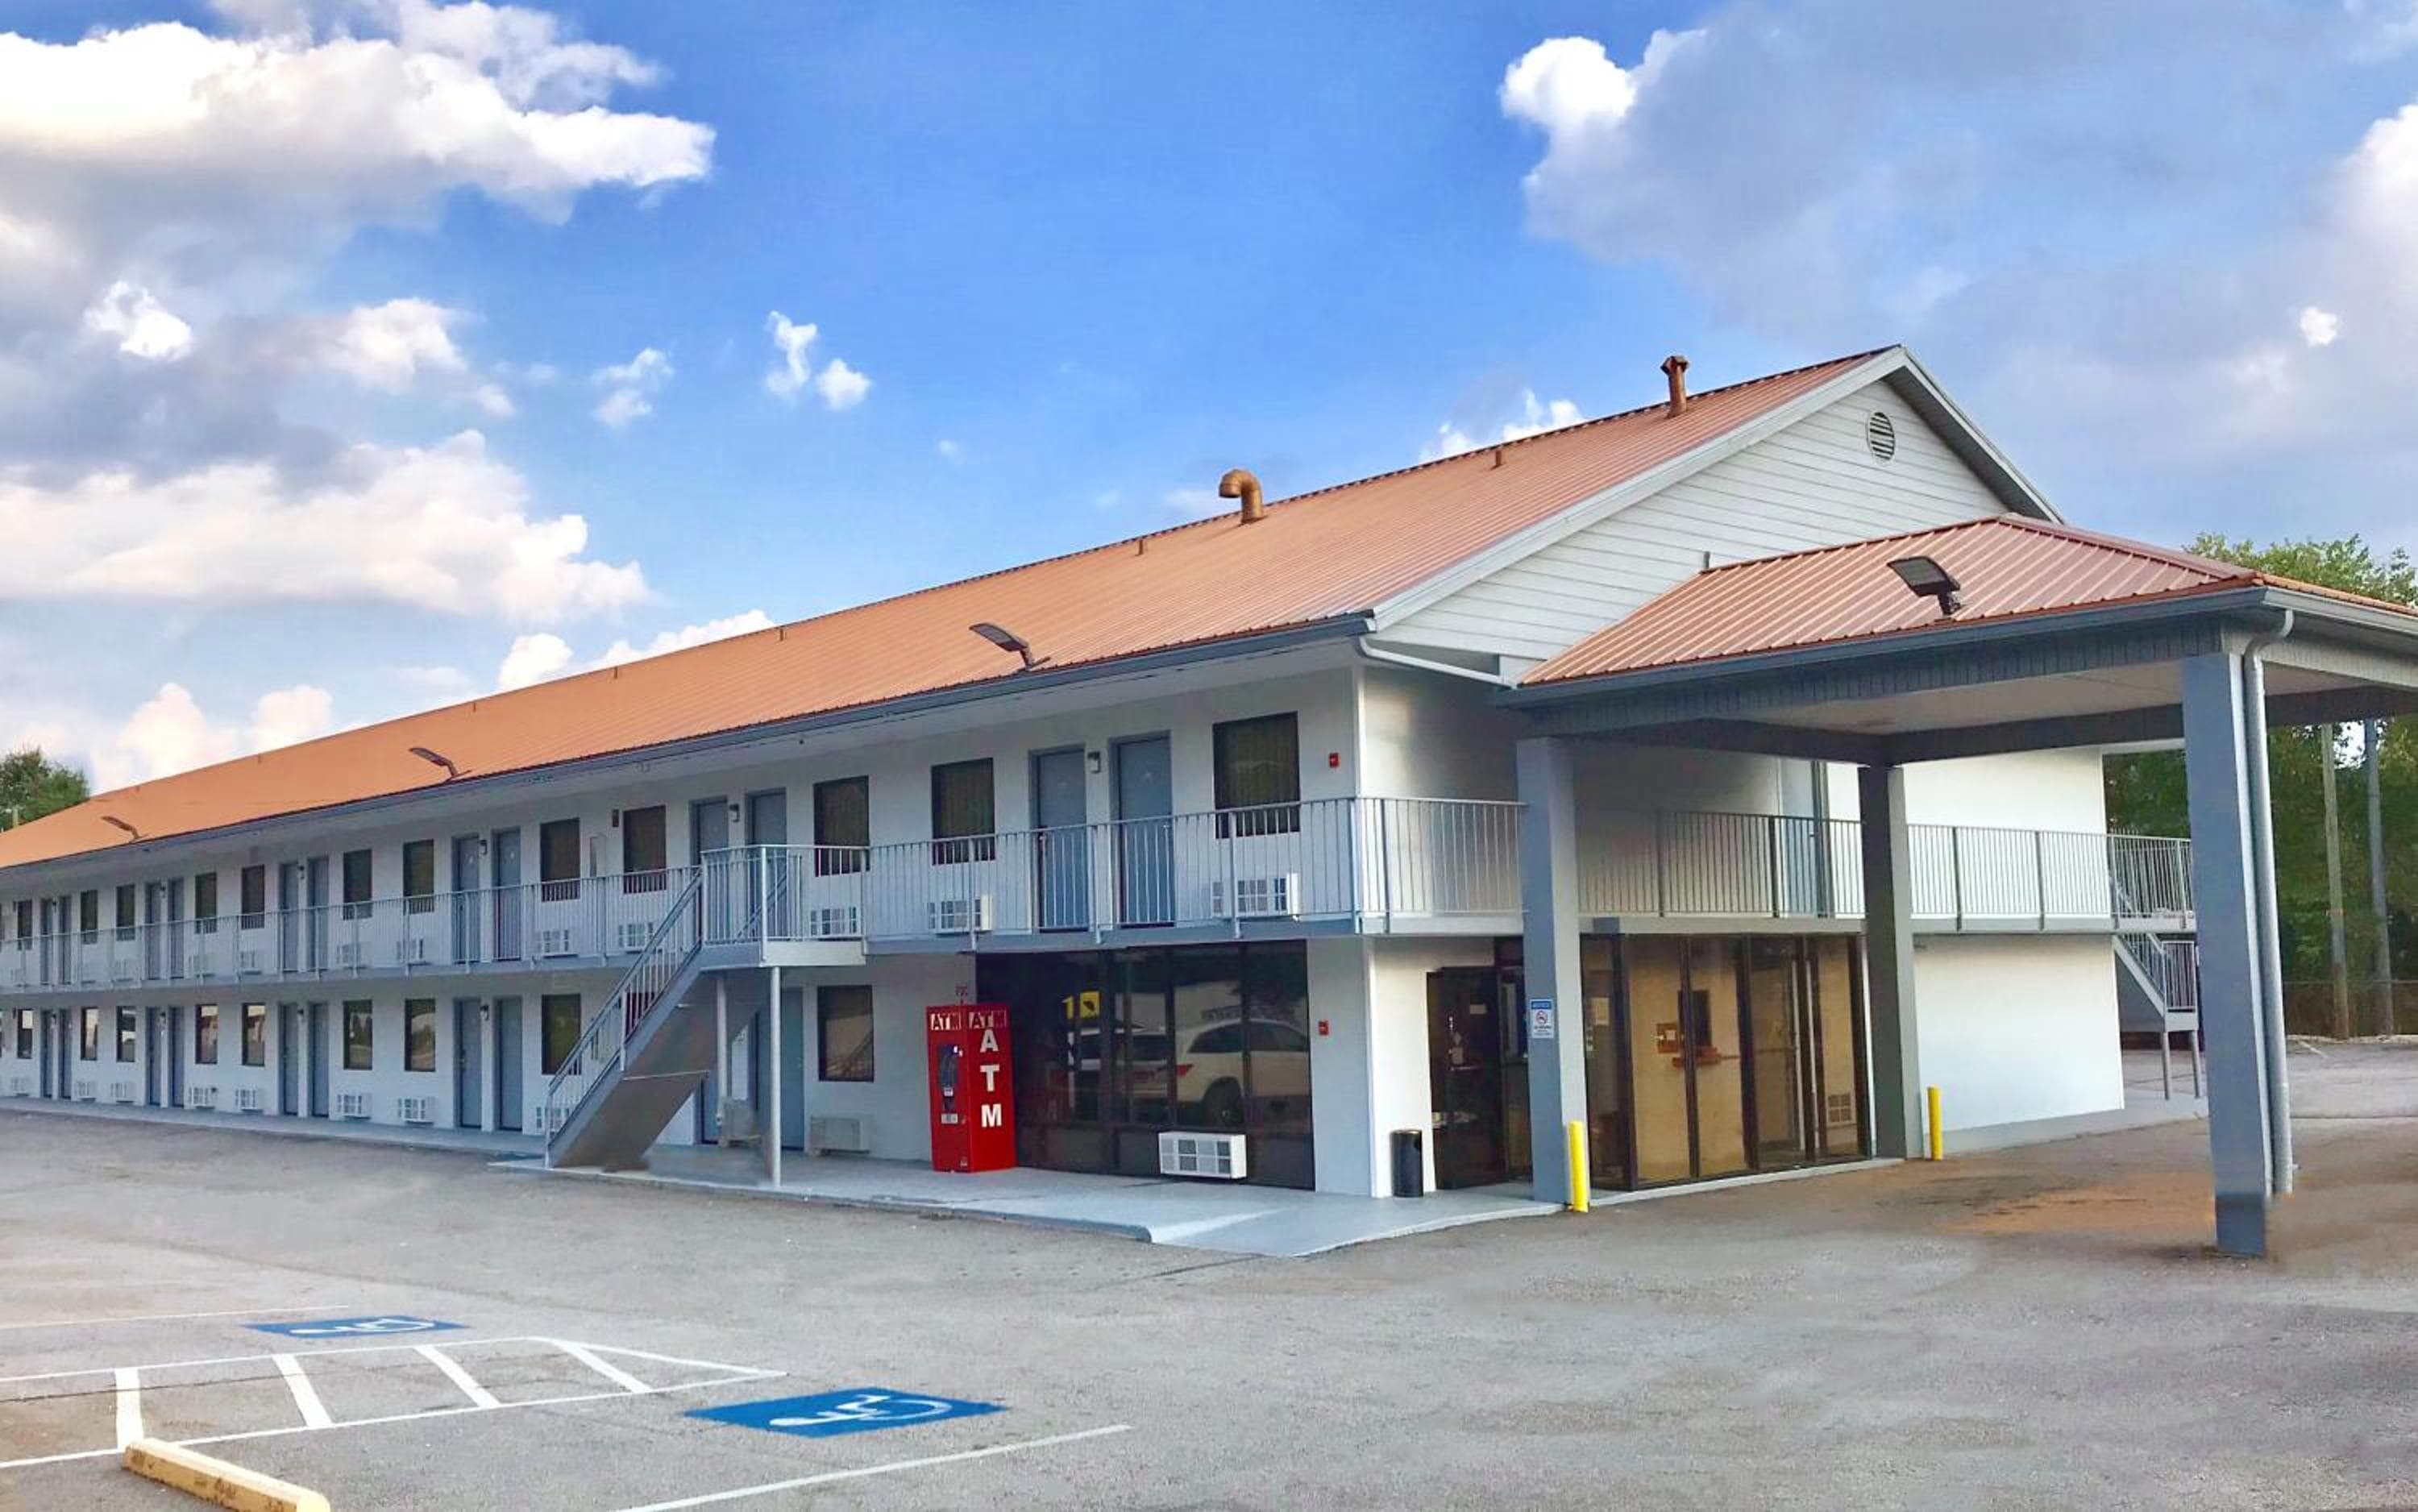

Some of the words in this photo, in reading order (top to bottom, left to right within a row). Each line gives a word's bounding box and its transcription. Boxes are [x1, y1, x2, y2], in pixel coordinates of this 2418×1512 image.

[931, 1013, 962, 1031] ATM
[970, 1010, 1007, 1029] ATM
[979, 1029, 1002, 1128] ATM
